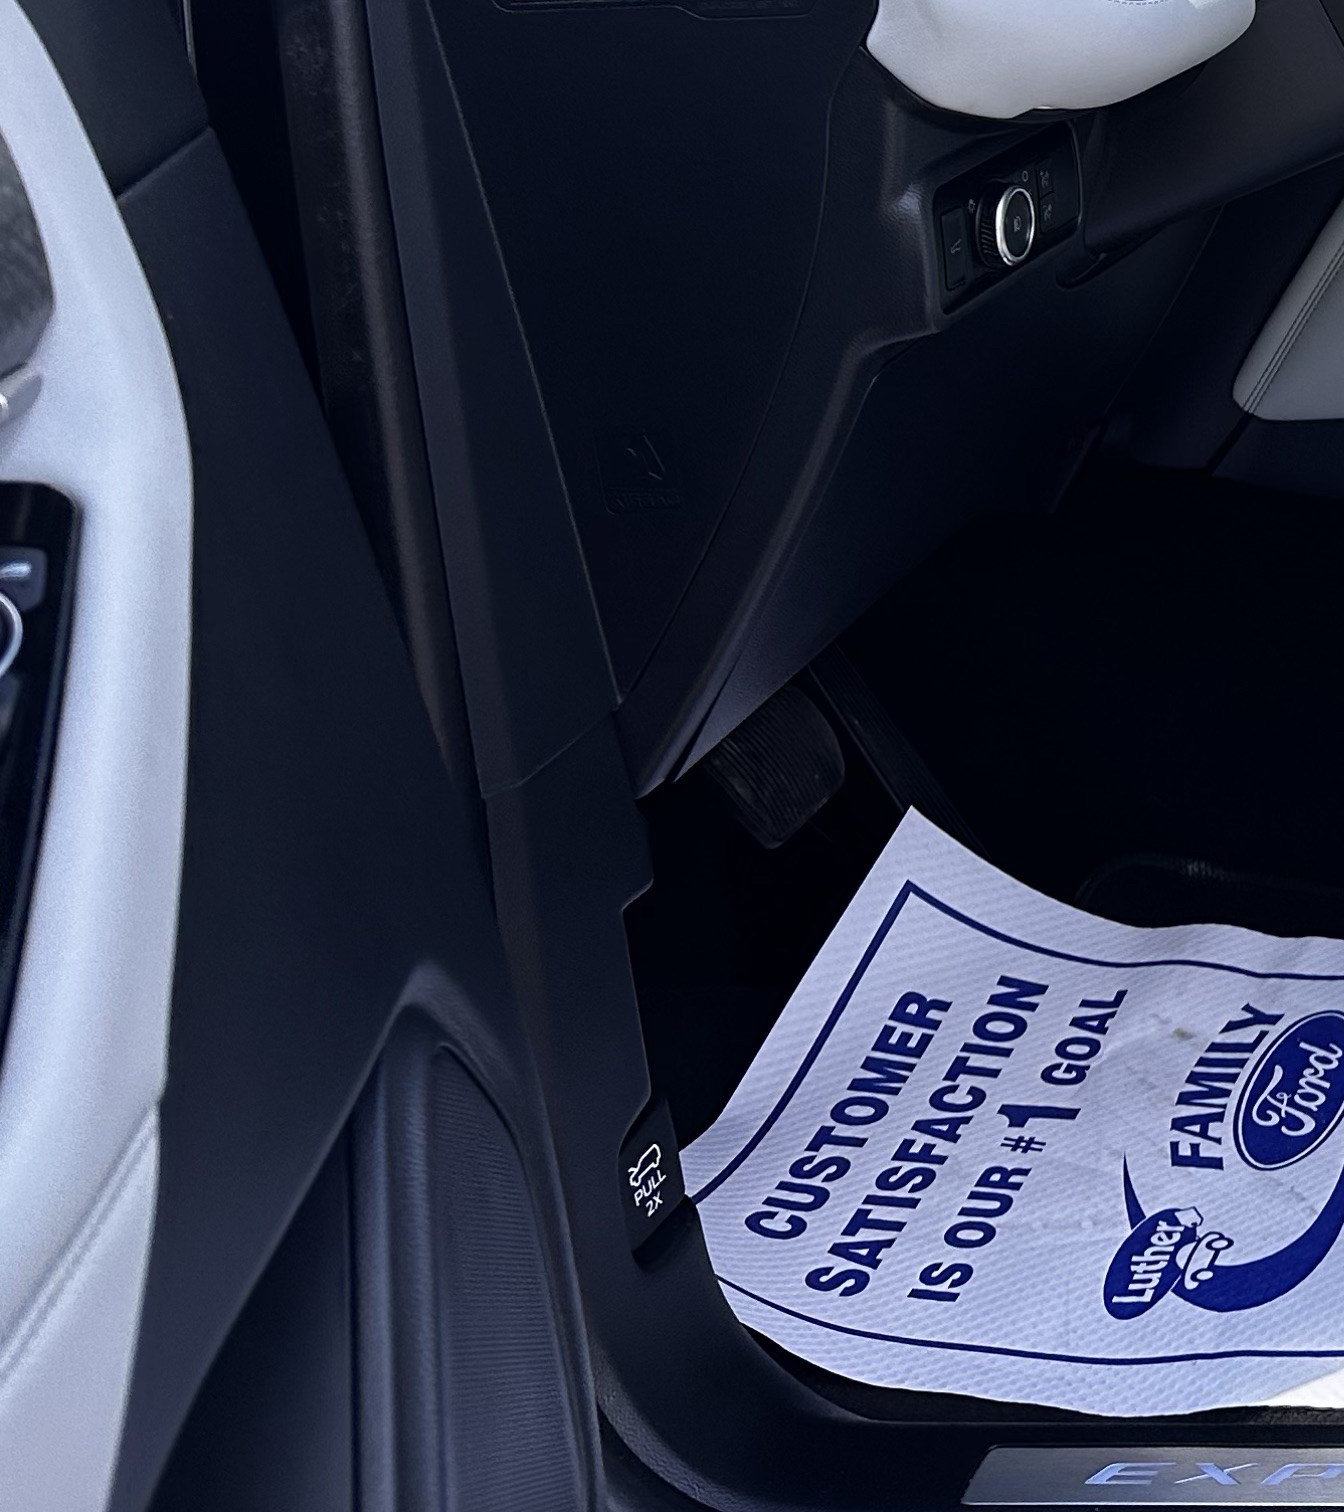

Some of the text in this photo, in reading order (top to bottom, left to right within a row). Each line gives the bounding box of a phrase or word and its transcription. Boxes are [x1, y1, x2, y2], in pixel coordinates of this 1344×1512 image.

[744, 990, 953, 1240] CUSTOMER
[804, 974, 1050, 1297] SATISFACTION
[906, 1261, 974, 1303] IS
[943, 1165, 1032, 1249] OUR
[1040, 989, 1128, 1087] GOAL
[1169, 1003, 1285, 1171] FAMILY
[1252, 1042, 1343, 1137] Ford
[633, 1169, 667, 1207] PULL
[645, 1191, 664, 1217] 2X
[1111, 1220, 1185, 1304] Luther
